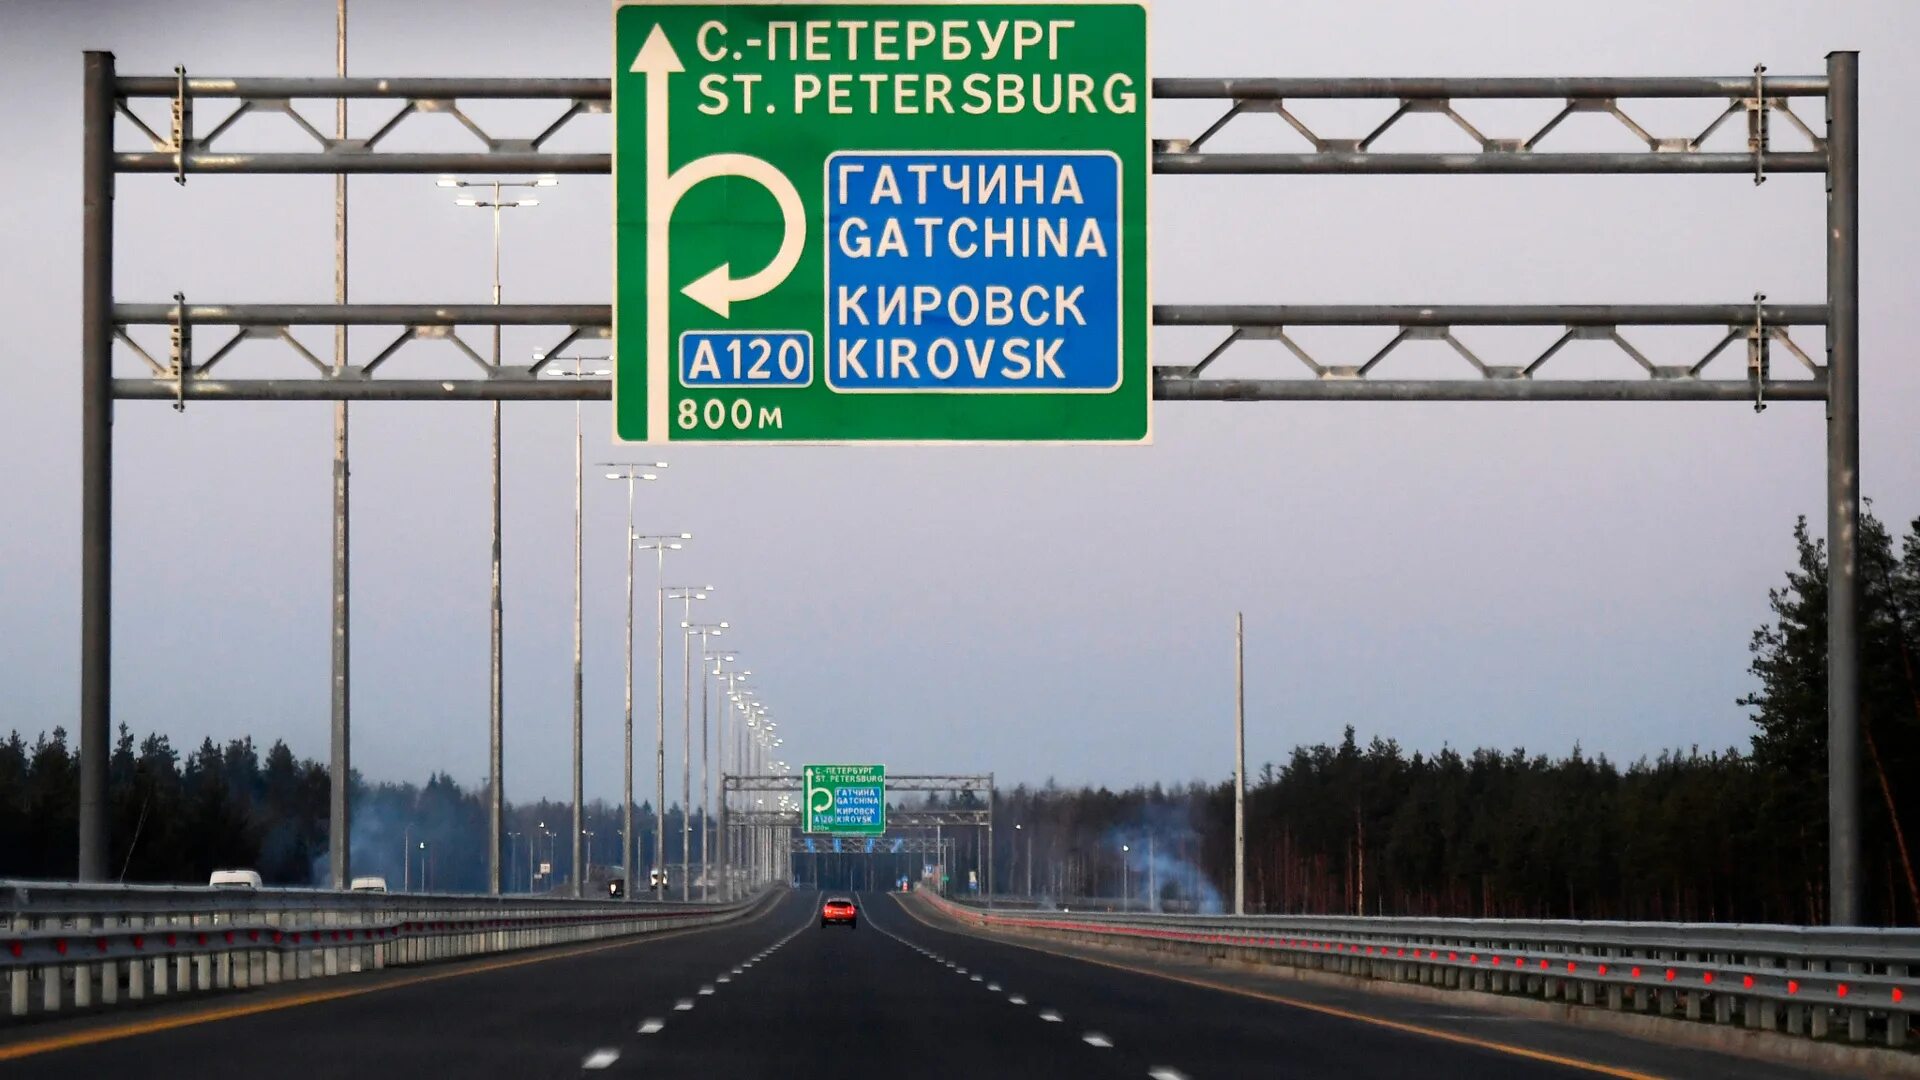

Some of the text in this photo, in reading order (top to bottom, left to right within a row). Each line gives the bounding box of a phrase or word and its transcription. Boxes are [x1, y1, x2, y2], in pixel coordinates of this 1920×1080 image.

[697, 21, 1074, 61] С.-ПЕТЕРБУРГ
[698, 73, 1136, 114] ST. PETERSBURG
[840, 165, 1083, 204] ГАТЧИНА
[839, 218, 1106, 258] GATCHINA
[839, 285, 1086, 326] КИРОВСК
[689, 339, 805, 380] A120
[840, 338, 1064, 379] KIROVSK
[830, 775, 883, 783] PETERSBURG
[836, 797, 879, 805] GATCHINA
[836, 807, 876, 815] КИРОВСК
[836, 815, 872, 823] KIROVSK
